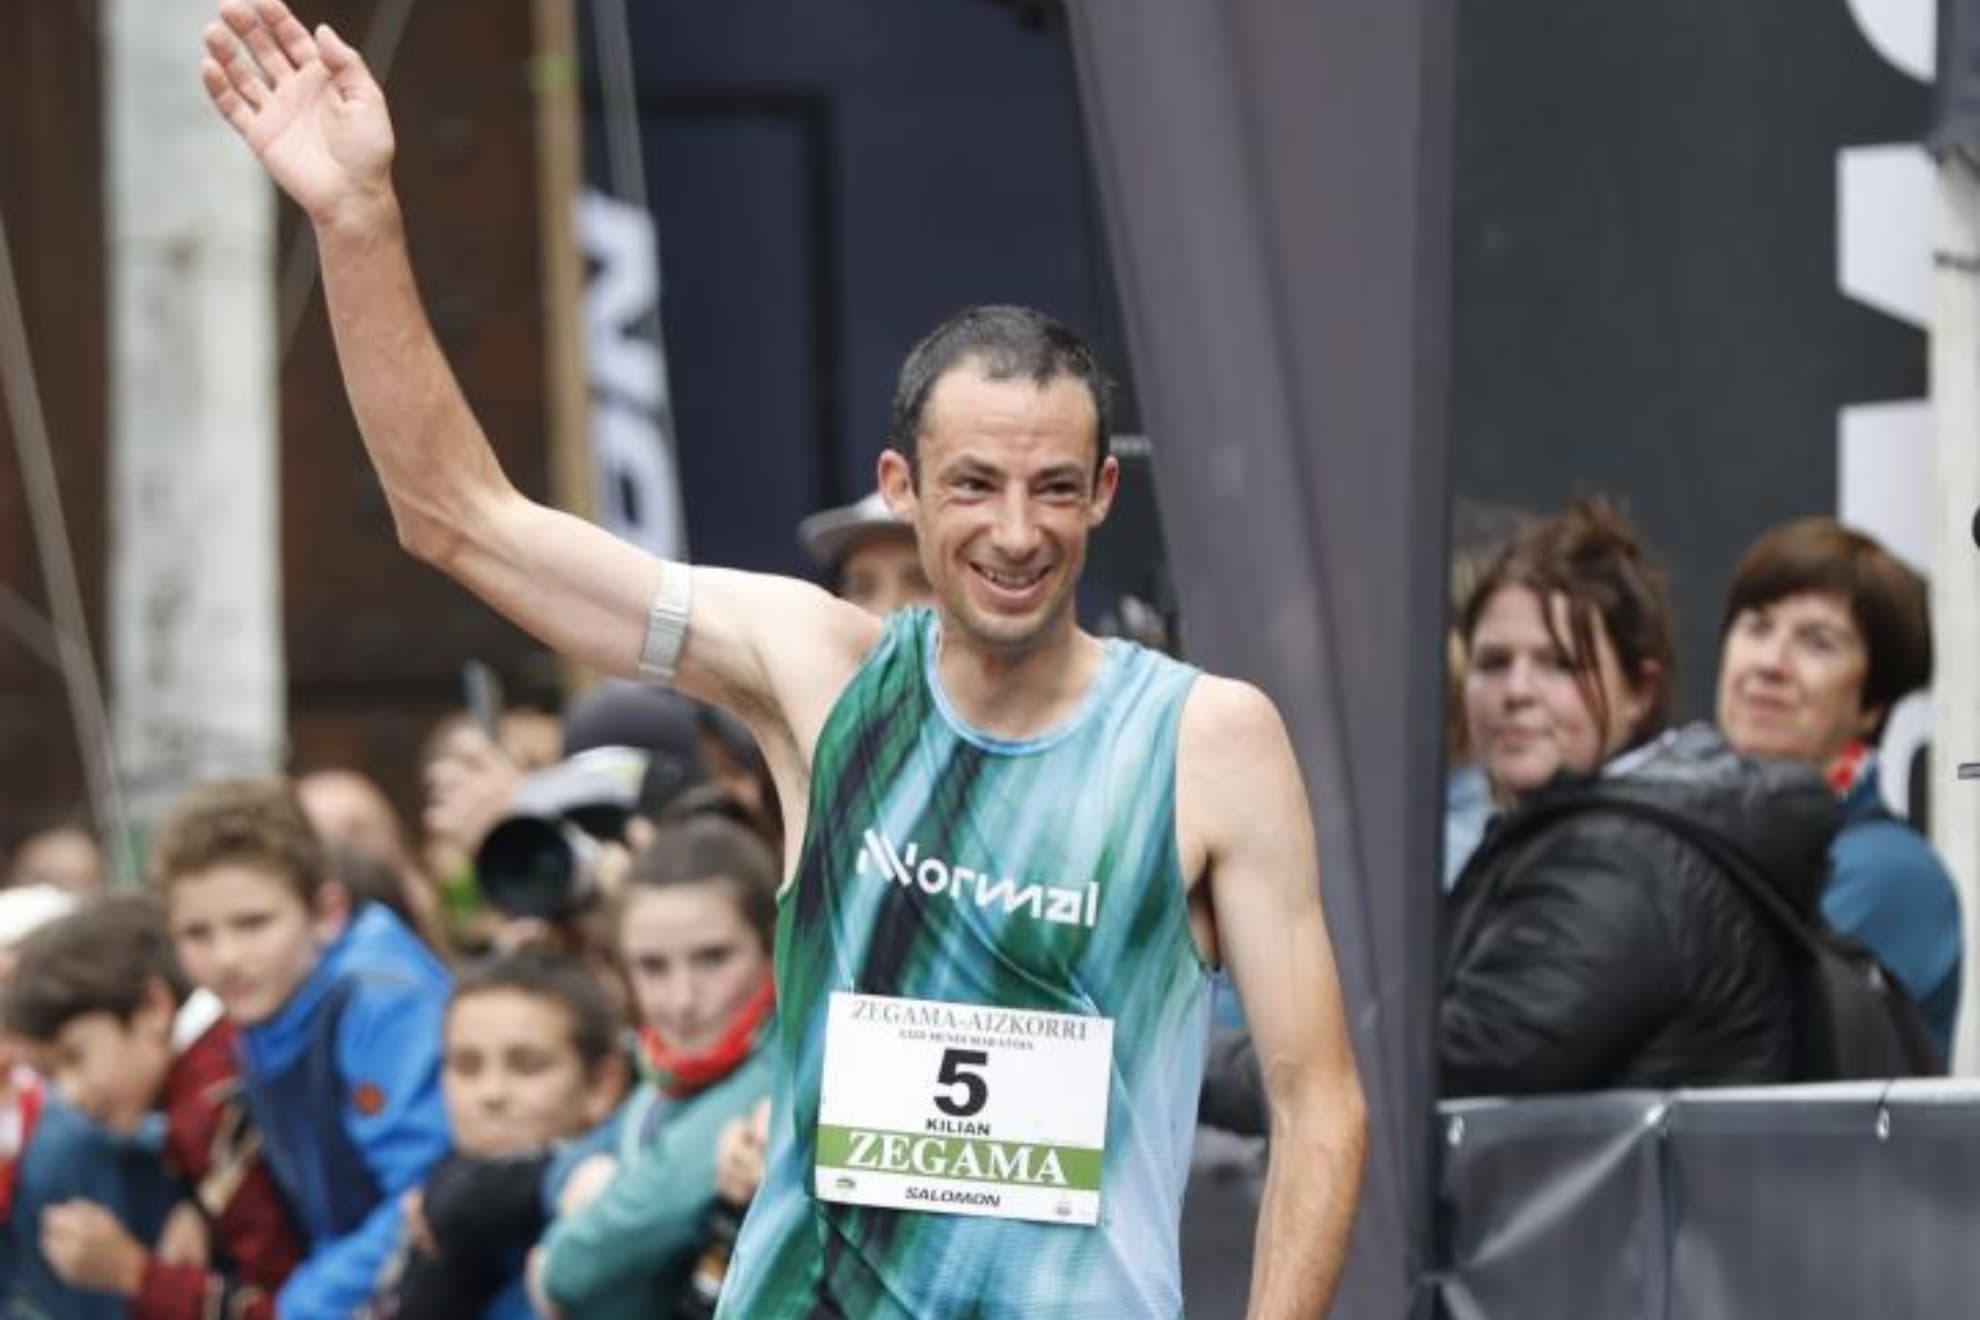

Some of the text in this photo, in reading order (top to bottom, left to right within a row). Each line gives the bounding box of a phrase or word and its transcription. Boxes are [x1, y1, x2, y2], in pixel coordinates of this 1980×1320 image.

[856, 829, 1099, 927] Normal
[851, 1000, 1088, 1041] ZEGAMA-AIZKORRI
[933, 1048, 988, 1117] 5
[926, 1118, 991, 1136] KILIAN
[846, 1131, 1068, 1185] ZEGAMA
[905, 1186, 1000, 1207] SALOMON
